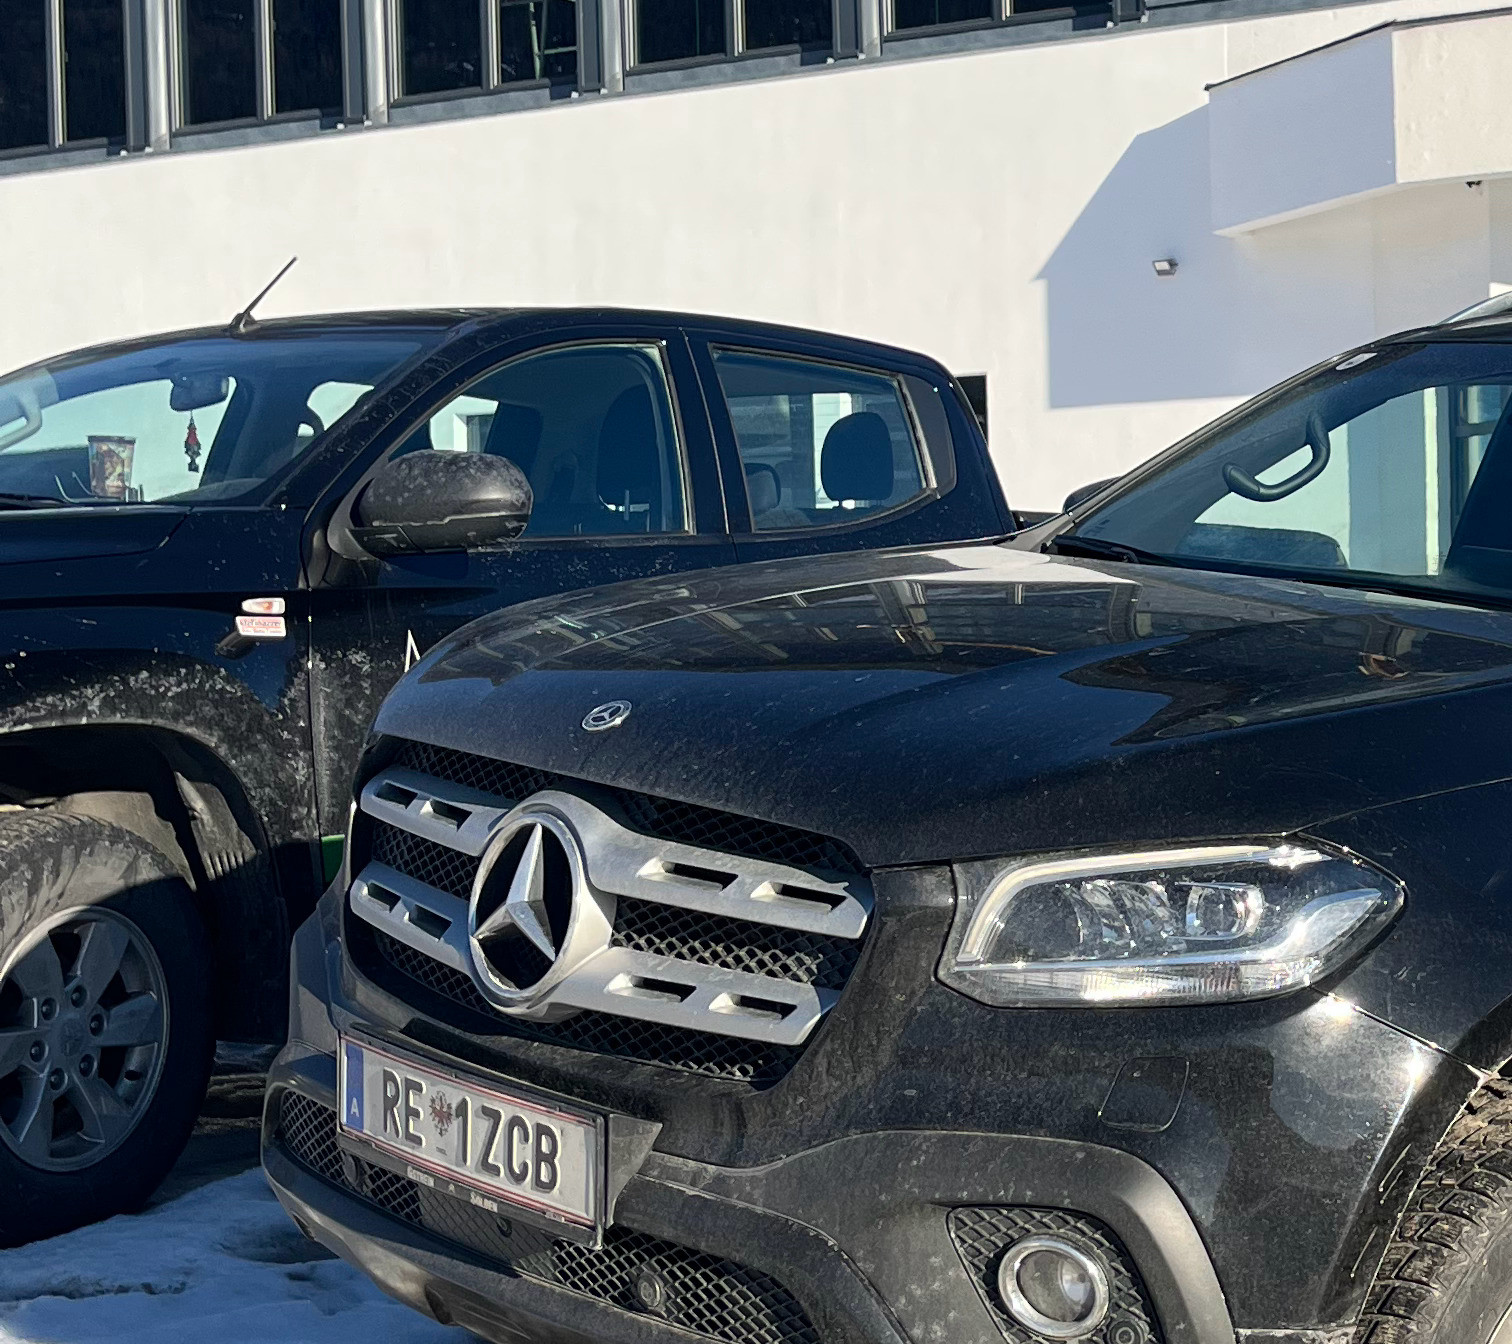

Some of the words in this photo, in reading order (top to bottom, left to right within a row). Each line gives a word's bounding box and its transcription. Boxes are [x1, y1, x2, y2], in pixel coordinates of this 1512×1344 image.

[350, 1097, 360, 1118] A
[382, 1066, 427, 1149] RE
[455, 1095, 562, 1194] 1ZCB
